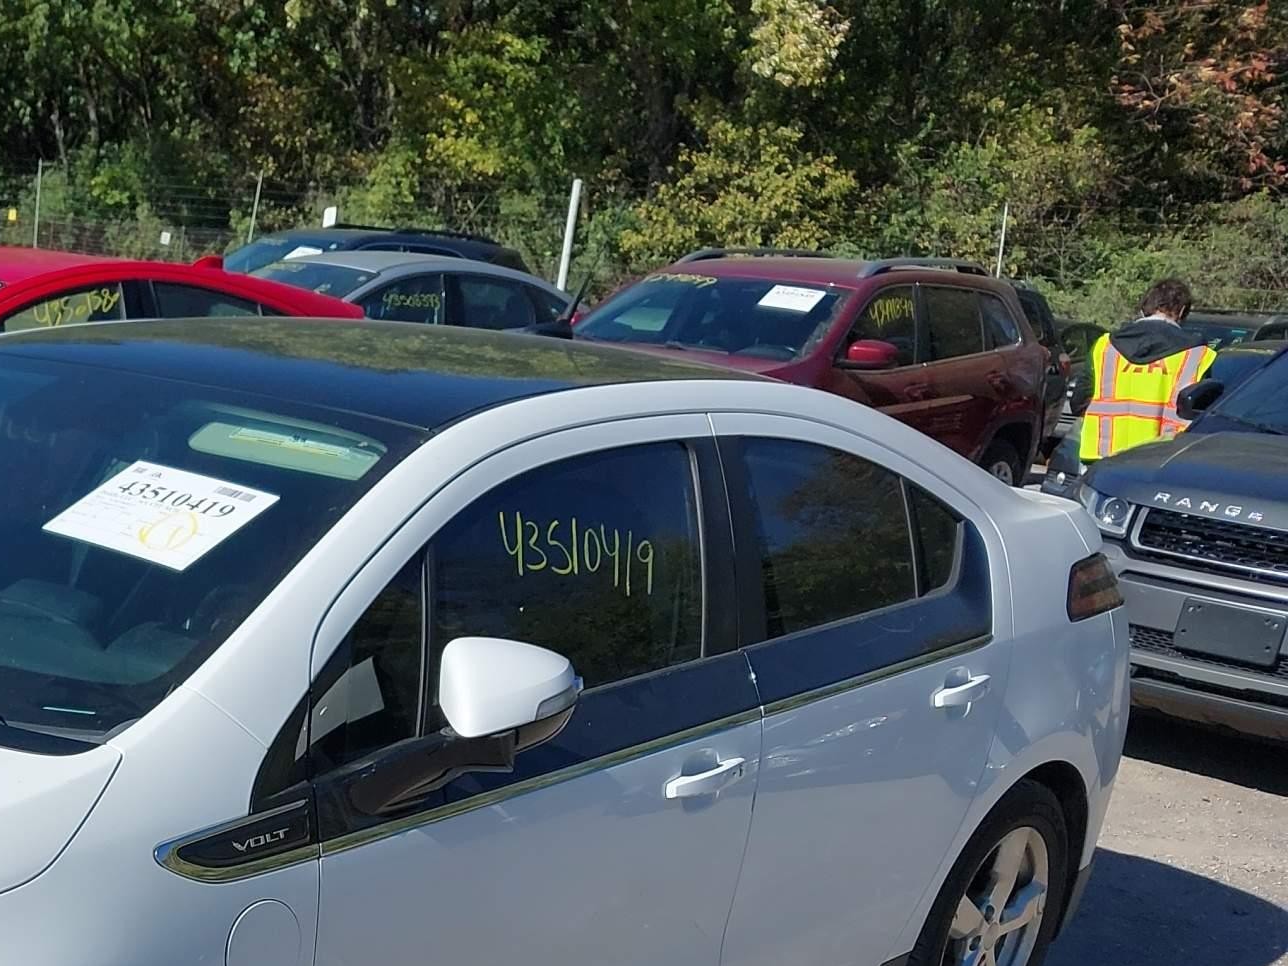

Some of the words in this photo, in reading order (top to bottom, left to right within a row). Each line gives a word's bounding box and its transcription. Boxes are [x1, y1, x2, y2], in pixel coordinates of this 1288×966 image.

[117, 480, 237, 519] 43510419
[1153, 490, 1266, 523] RANGE
[497, 510, 656, 597] 43510419
[231, 827, 290, 853] VOLT
